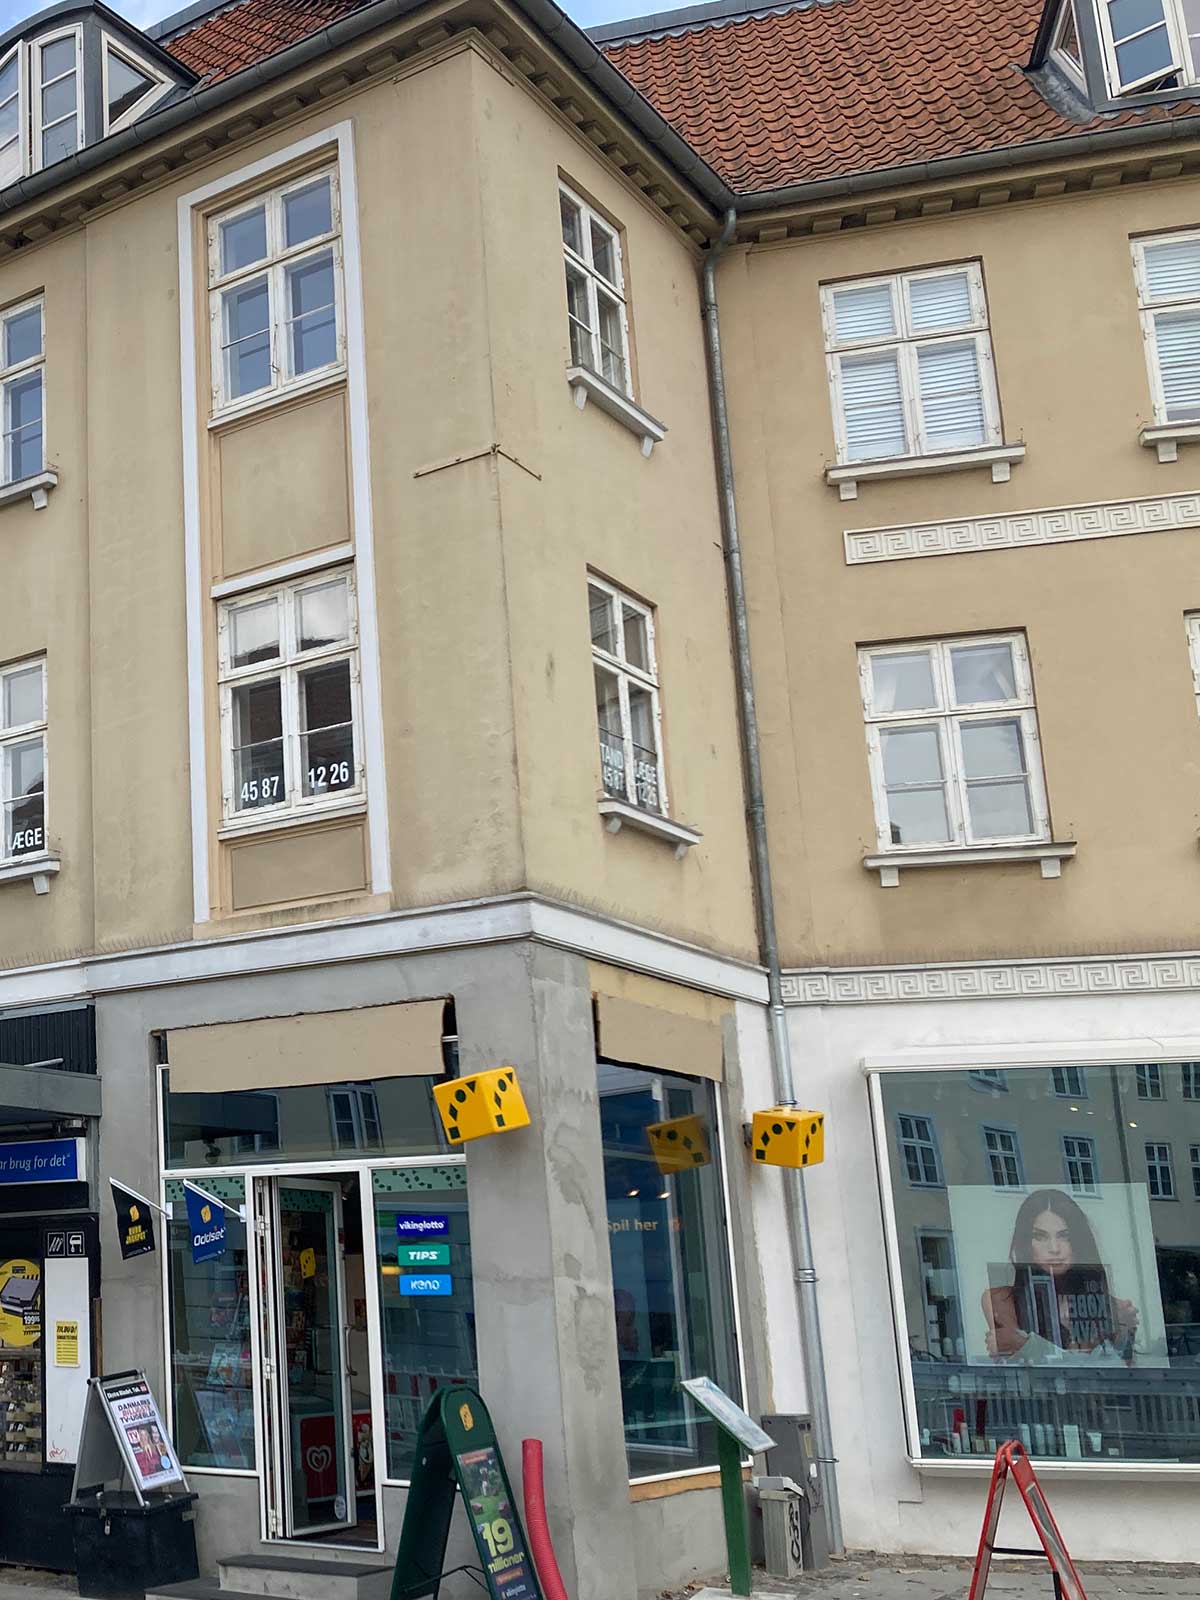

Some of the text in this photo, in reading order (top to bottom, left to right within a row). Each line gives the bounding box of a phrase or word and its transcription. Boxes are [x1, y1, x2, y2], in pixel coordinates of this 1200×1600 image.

[240, 761, 349, 802] 45 87 12 26
[9, 1155, 31, 1171] brug
[33, 1155, 48, 1169] for
[399, 1220, 445, 1232] vikinglotto
[634, 1218, 658, 1232] her
[193, 1229, 225, 1246] Oddset
[408, 1251, 438, 1260] TIPS
[482, 1518, 514, 1557] 19
[488, 1551, 525, 1574] millioner
